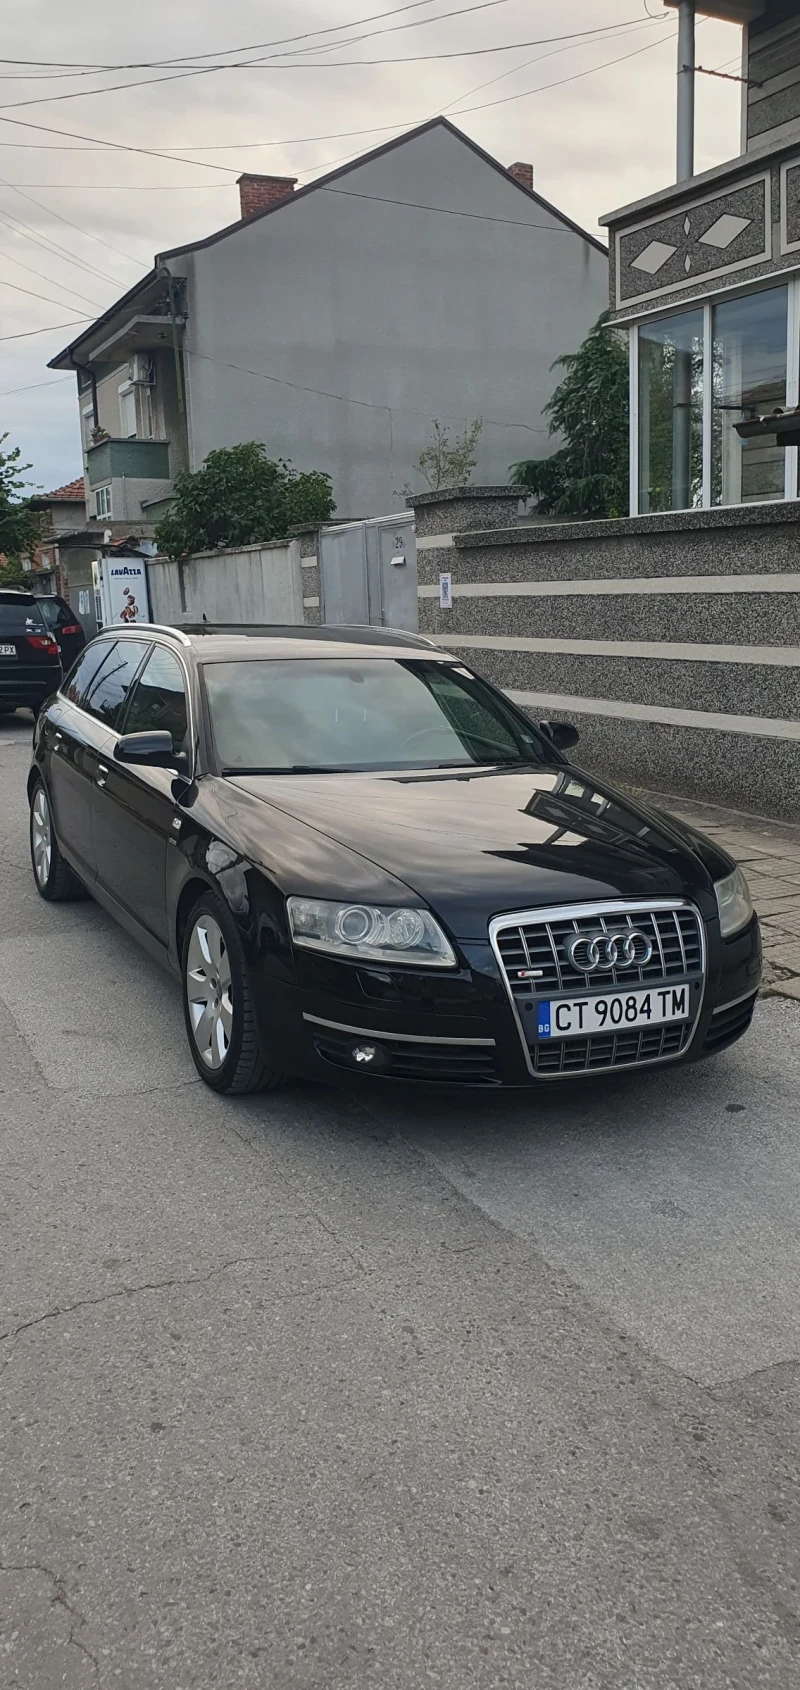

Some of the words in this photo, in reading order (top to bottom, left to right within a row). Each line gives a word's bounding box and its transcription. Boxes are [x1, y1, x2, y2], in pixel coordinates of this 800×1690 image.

[395, 536, 403, 549] 29
[110, 566, 142, 576] LAVAZZA
[555, 1001, 589, 1031] CT
[594, 993, 652, 1027] 9084
[657, 987, 686, 1018] TM
[538, 1023, 550, 1033] BG
